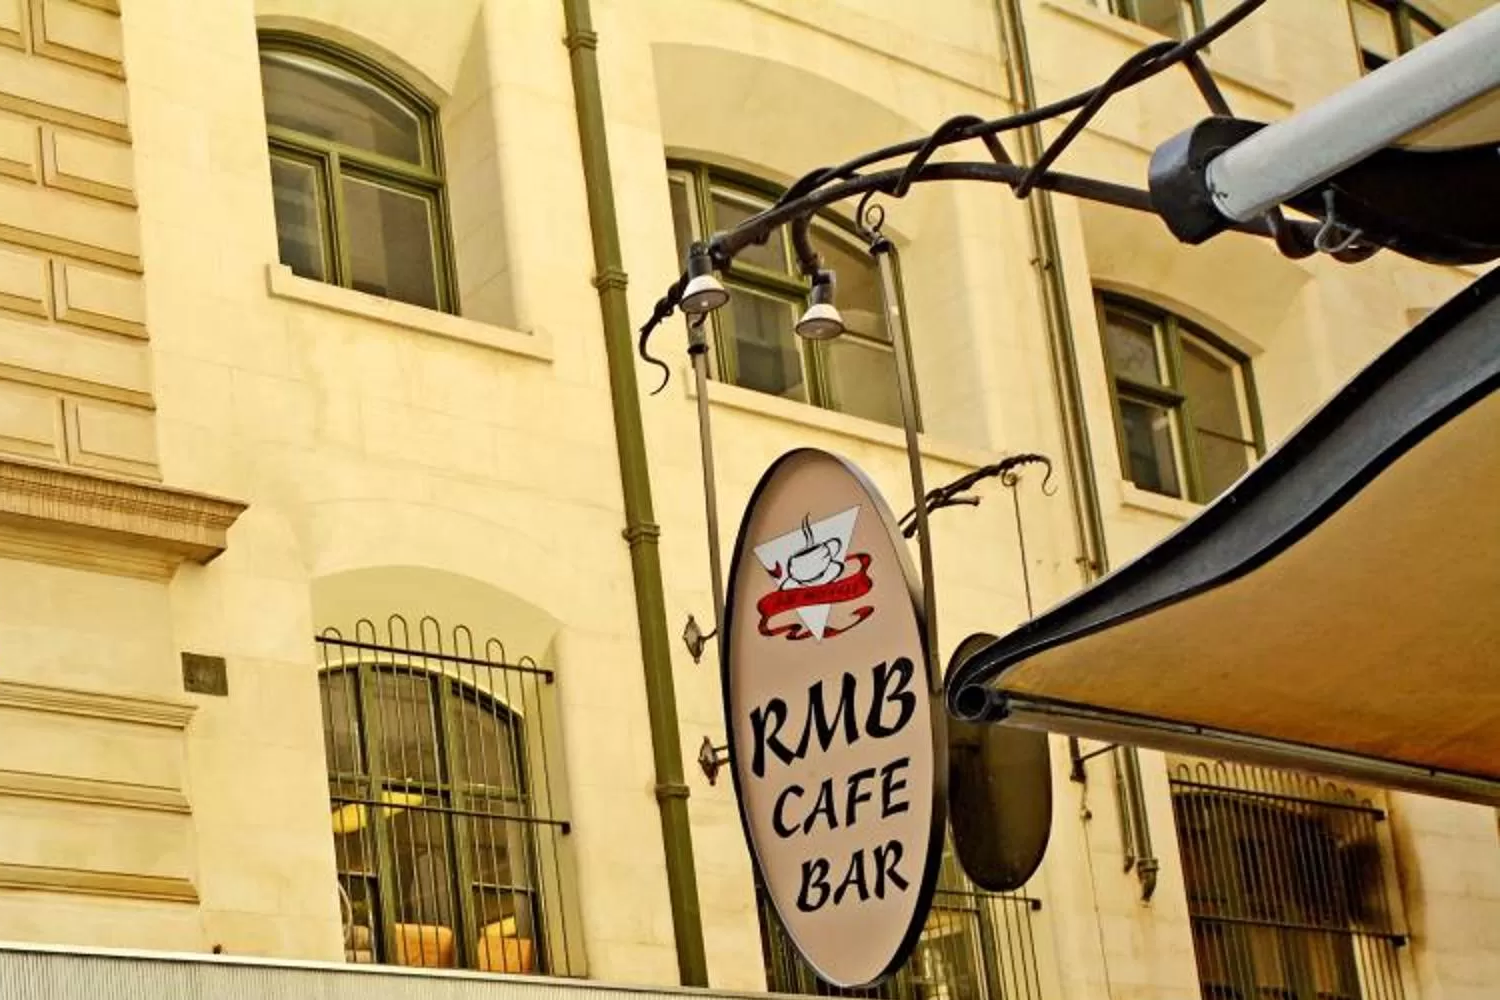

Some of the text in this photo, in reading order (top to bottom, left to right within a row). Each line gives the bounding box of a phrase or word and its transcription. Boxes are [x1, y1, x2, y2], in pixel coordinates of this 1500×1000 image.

[750, 656, 916, 778] RMB
[772, 757, 910, 839] CAFE
[796, 839, 909, 913] BAR
